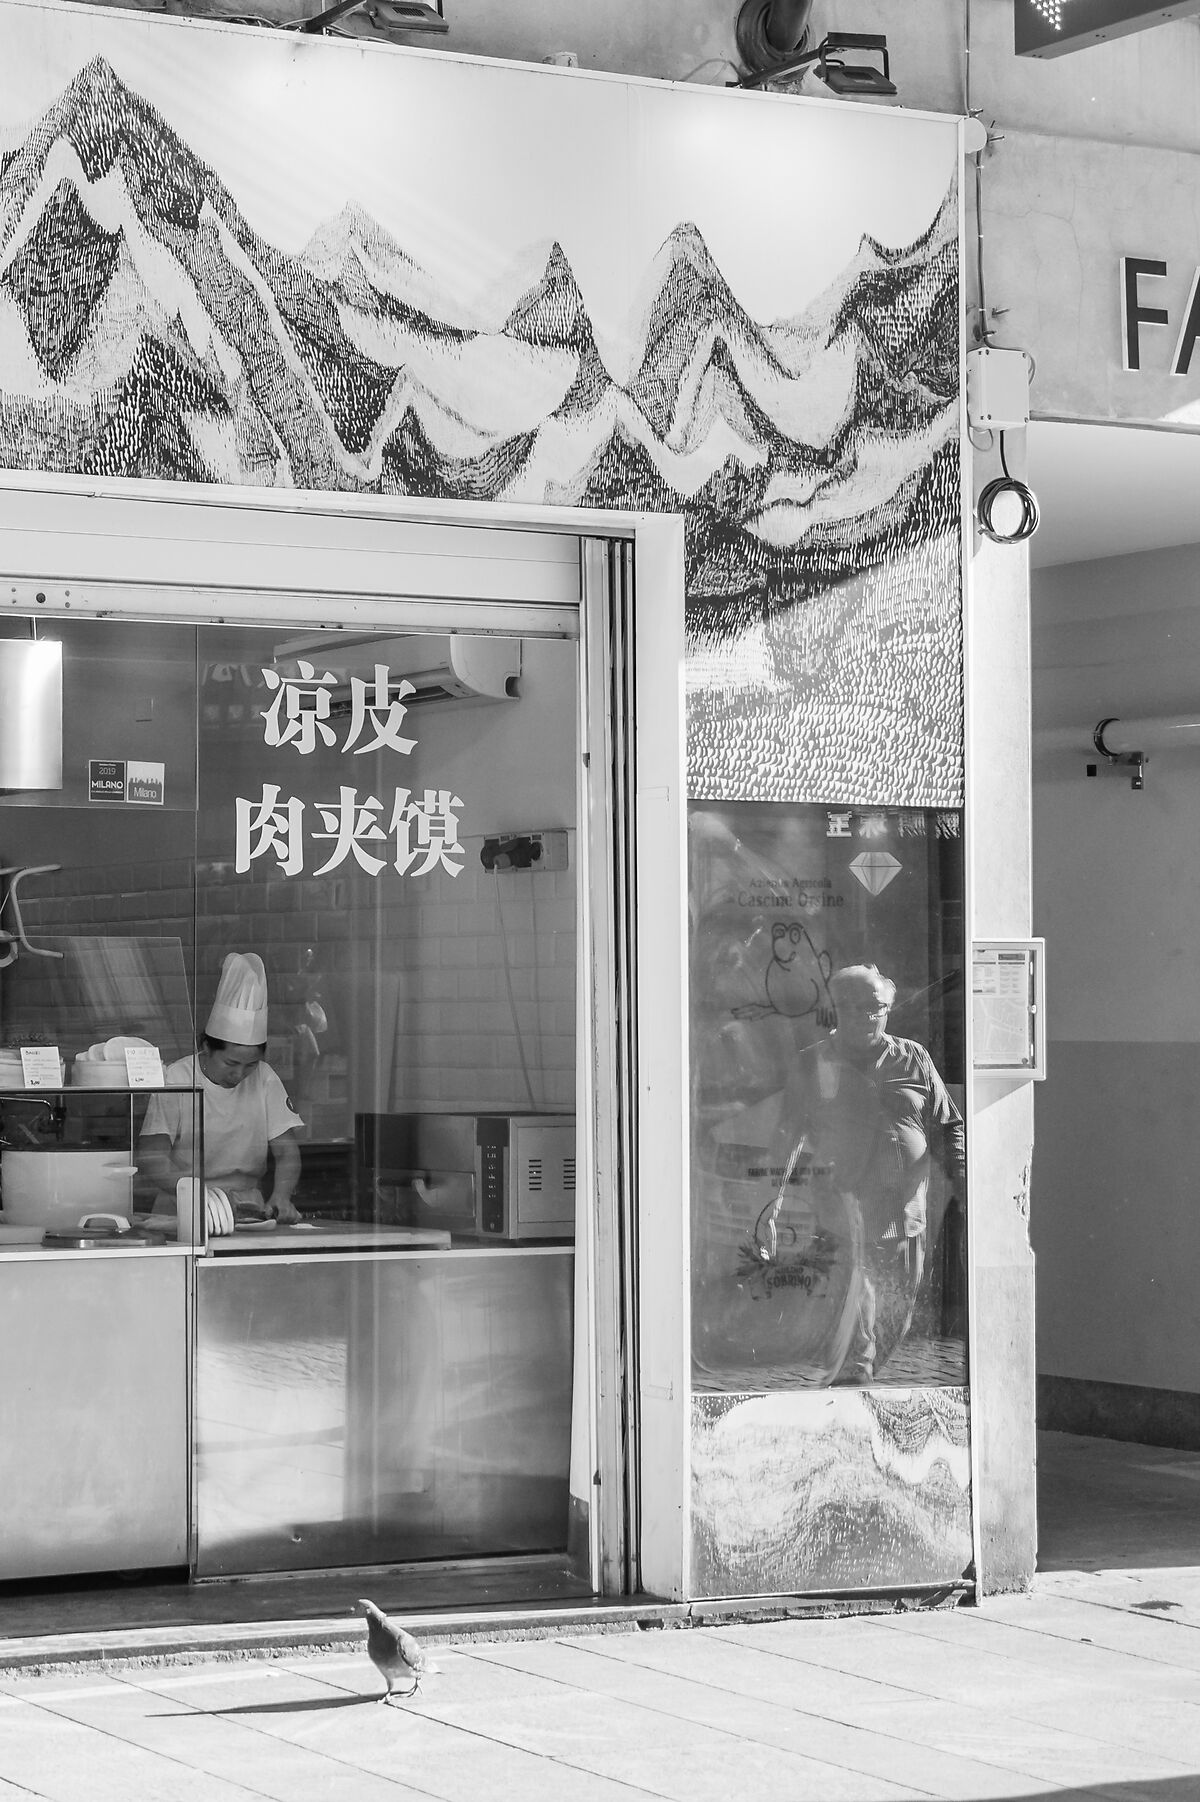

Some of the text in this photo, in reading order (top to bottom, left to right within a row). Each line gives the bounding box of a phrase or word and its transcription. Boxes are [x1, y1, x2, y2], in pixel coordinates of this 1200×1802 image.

[260, 660, 418, 755] 凉皮
[99, 767, 116, 775] 2019
[91, 780, 124, 789] MILANO
[133, 787, 157, 798] Milano
[235, 783, 465, 878] 肉夹馍
